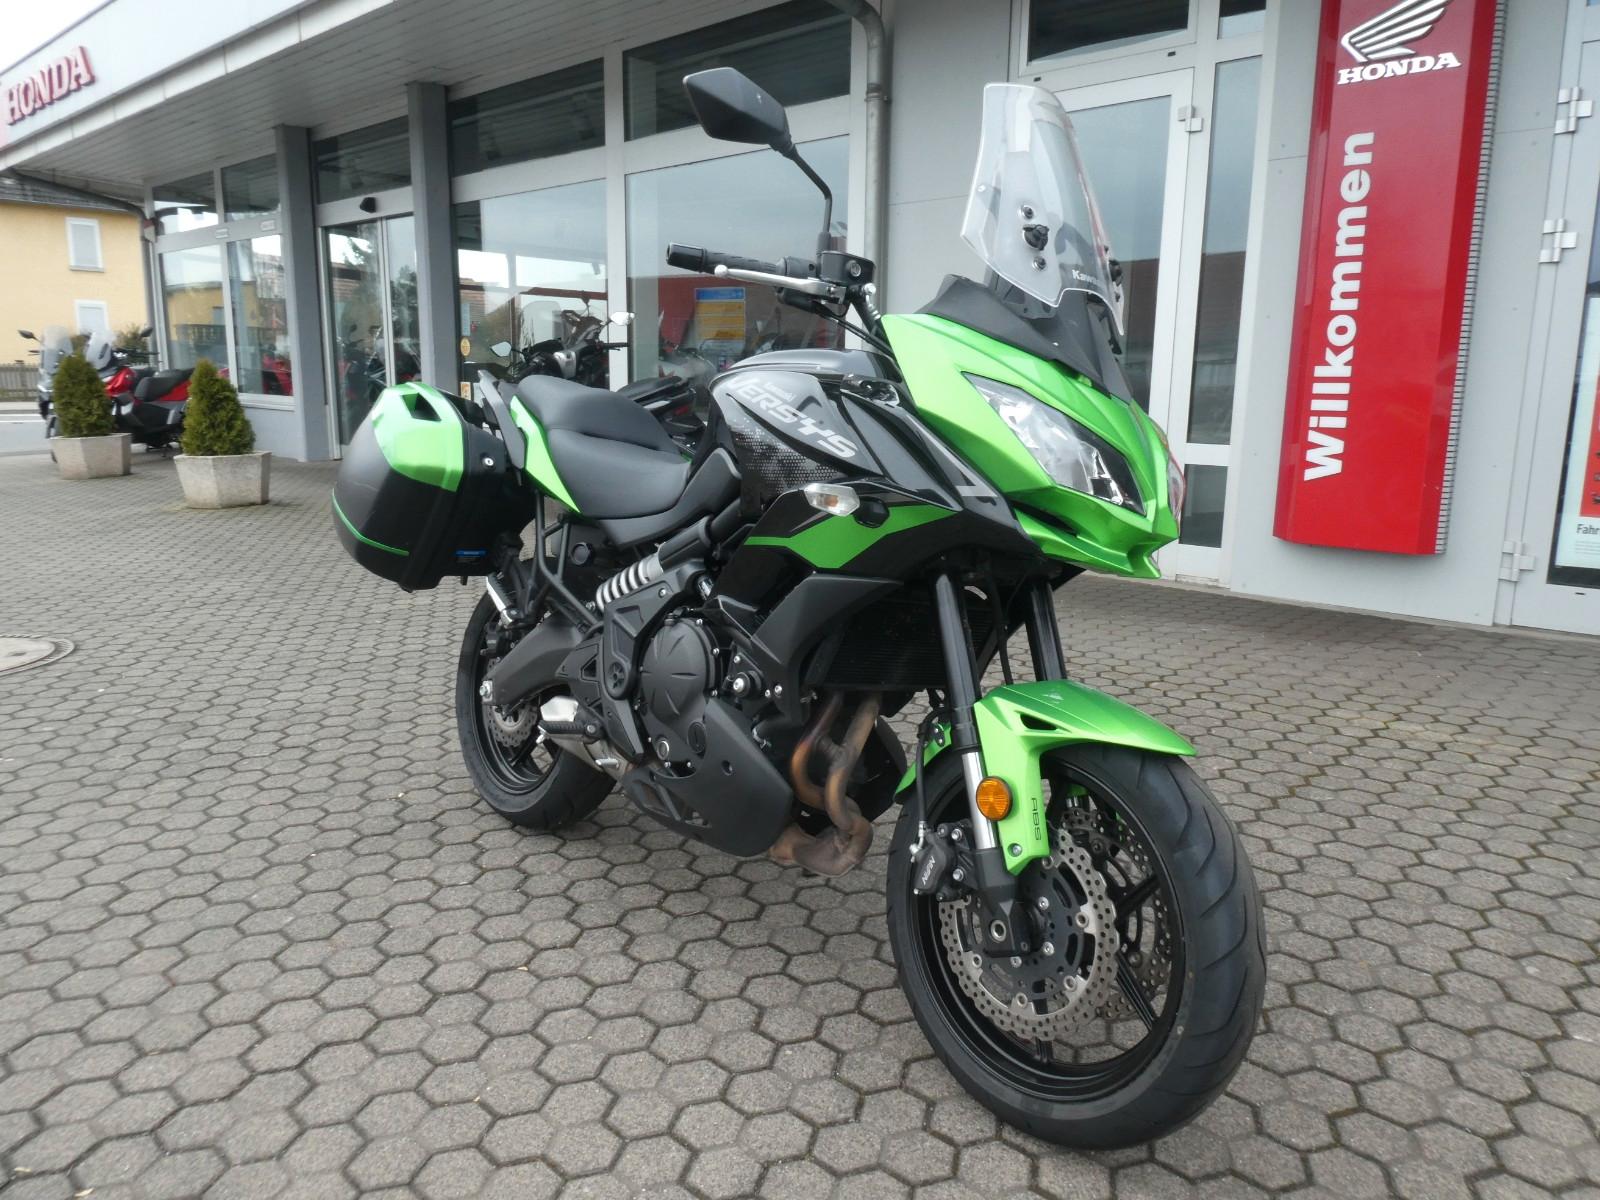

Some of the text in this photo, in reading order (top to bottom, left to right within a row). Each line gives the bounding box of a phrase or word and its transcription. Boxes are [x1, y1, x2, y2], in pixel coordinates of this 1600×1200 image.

[6, 45, 96, 126] HONDA
[1337, 52, 1462, 85] HONDA
[1304, 131, 1375, 481] Willkommen
[726, 377, 858, 458] VERSYS
[1031, 797, 1042, 841] ABS
